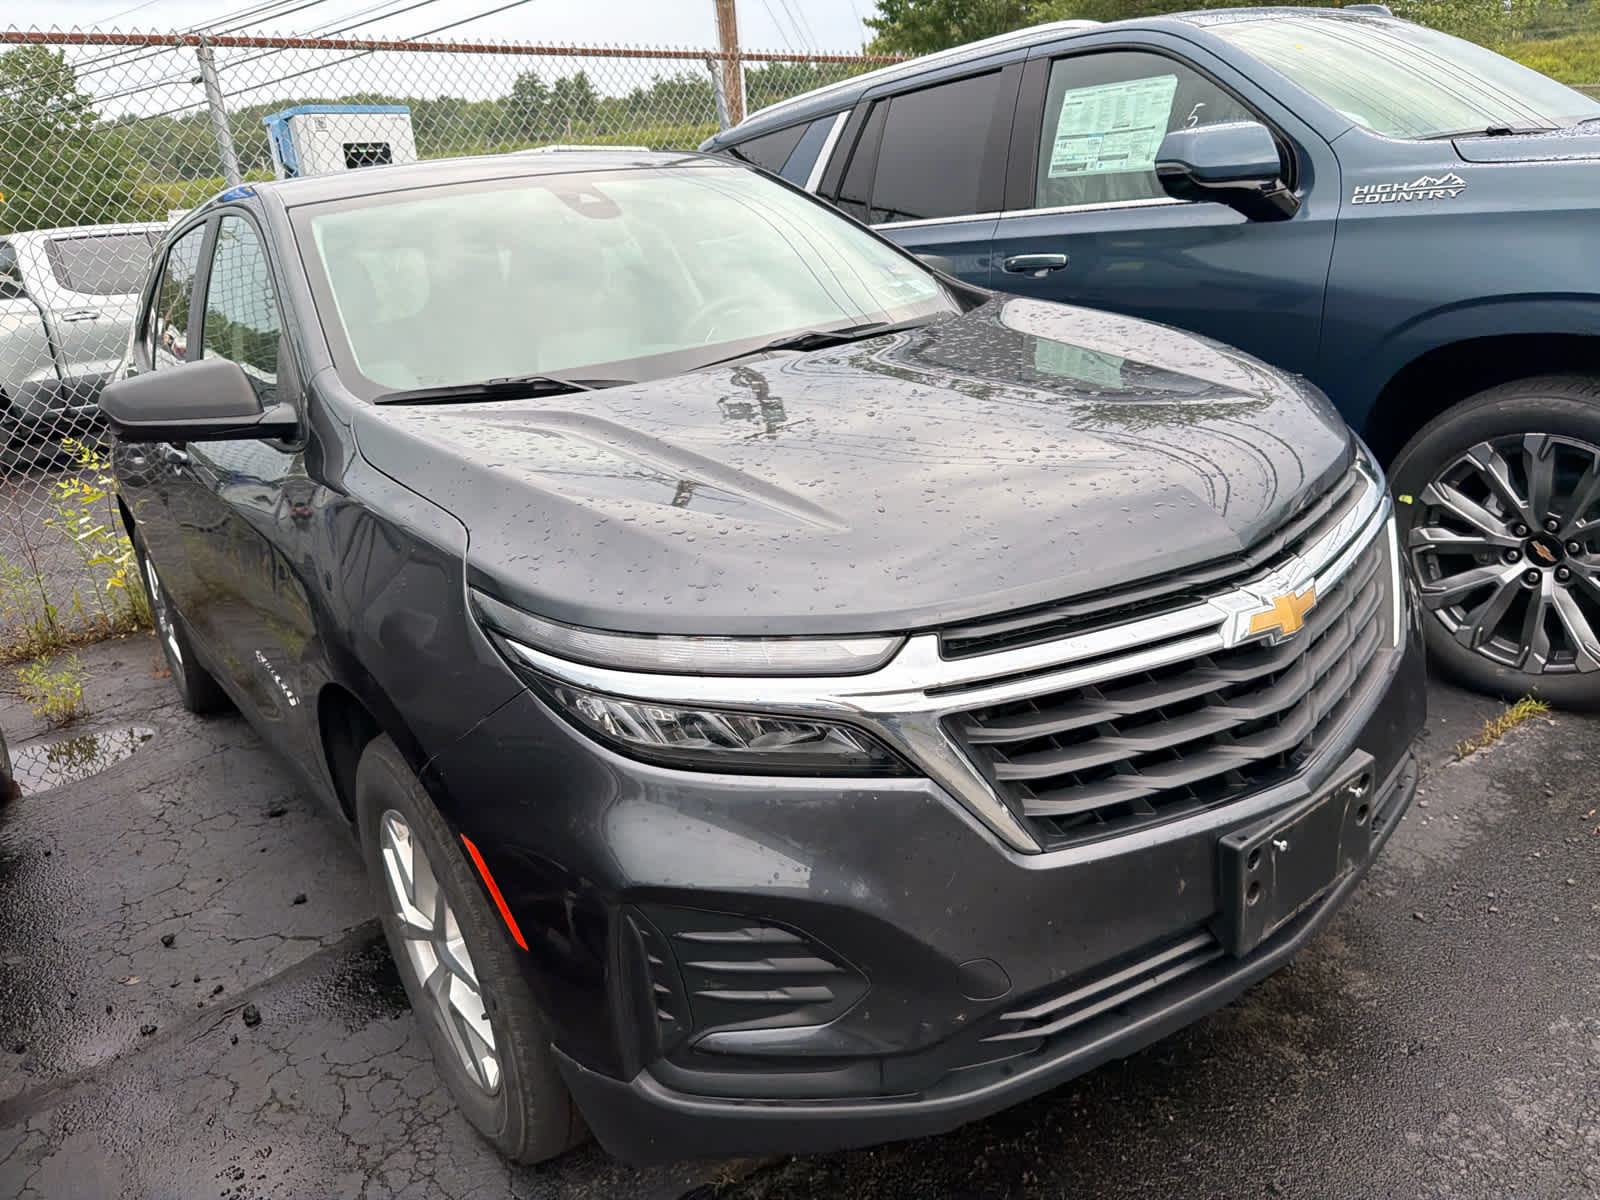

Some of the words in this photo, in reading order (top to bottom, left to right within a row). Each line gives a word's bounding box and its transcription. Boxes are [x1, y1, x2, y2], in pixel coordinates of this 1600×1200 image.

[1184, 102, 1206, 128] 5
[1352, 188, 1465, 205] COUNTRY
[1354, 182, 1409, 195] HIGH
